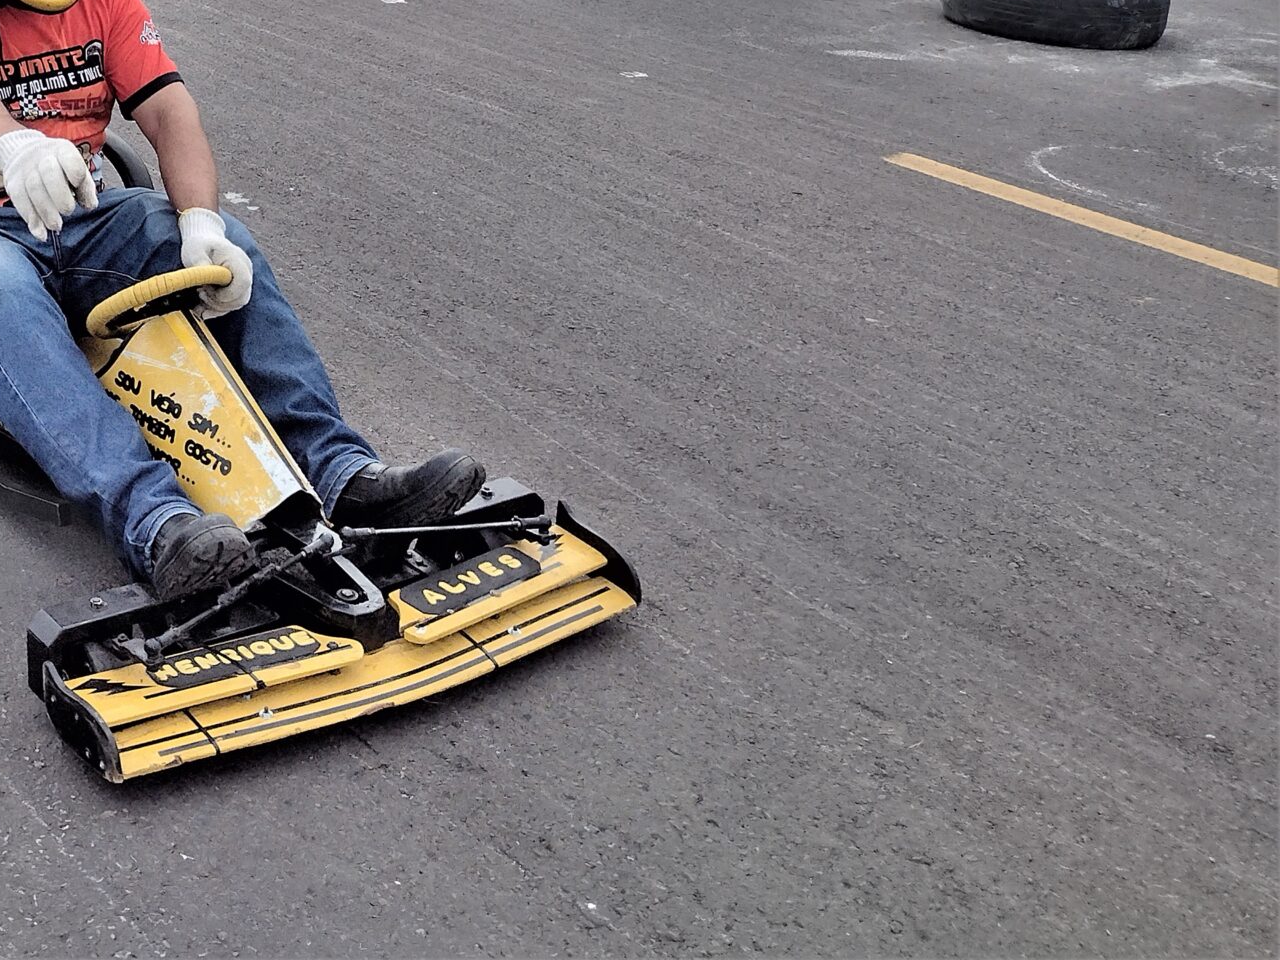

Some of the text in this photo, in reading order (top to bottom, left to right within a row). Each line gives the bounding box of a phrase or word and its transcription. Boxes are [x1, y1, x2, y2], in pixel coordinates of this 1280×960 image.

[68, 72, 76, 85] E
[114, 370, 142, 395] SOU
[184, 439, 232, 476] GOSTO
[421, 553, 523, 606] ALVES
[154, 631, 317, 681] HENRIQUE
